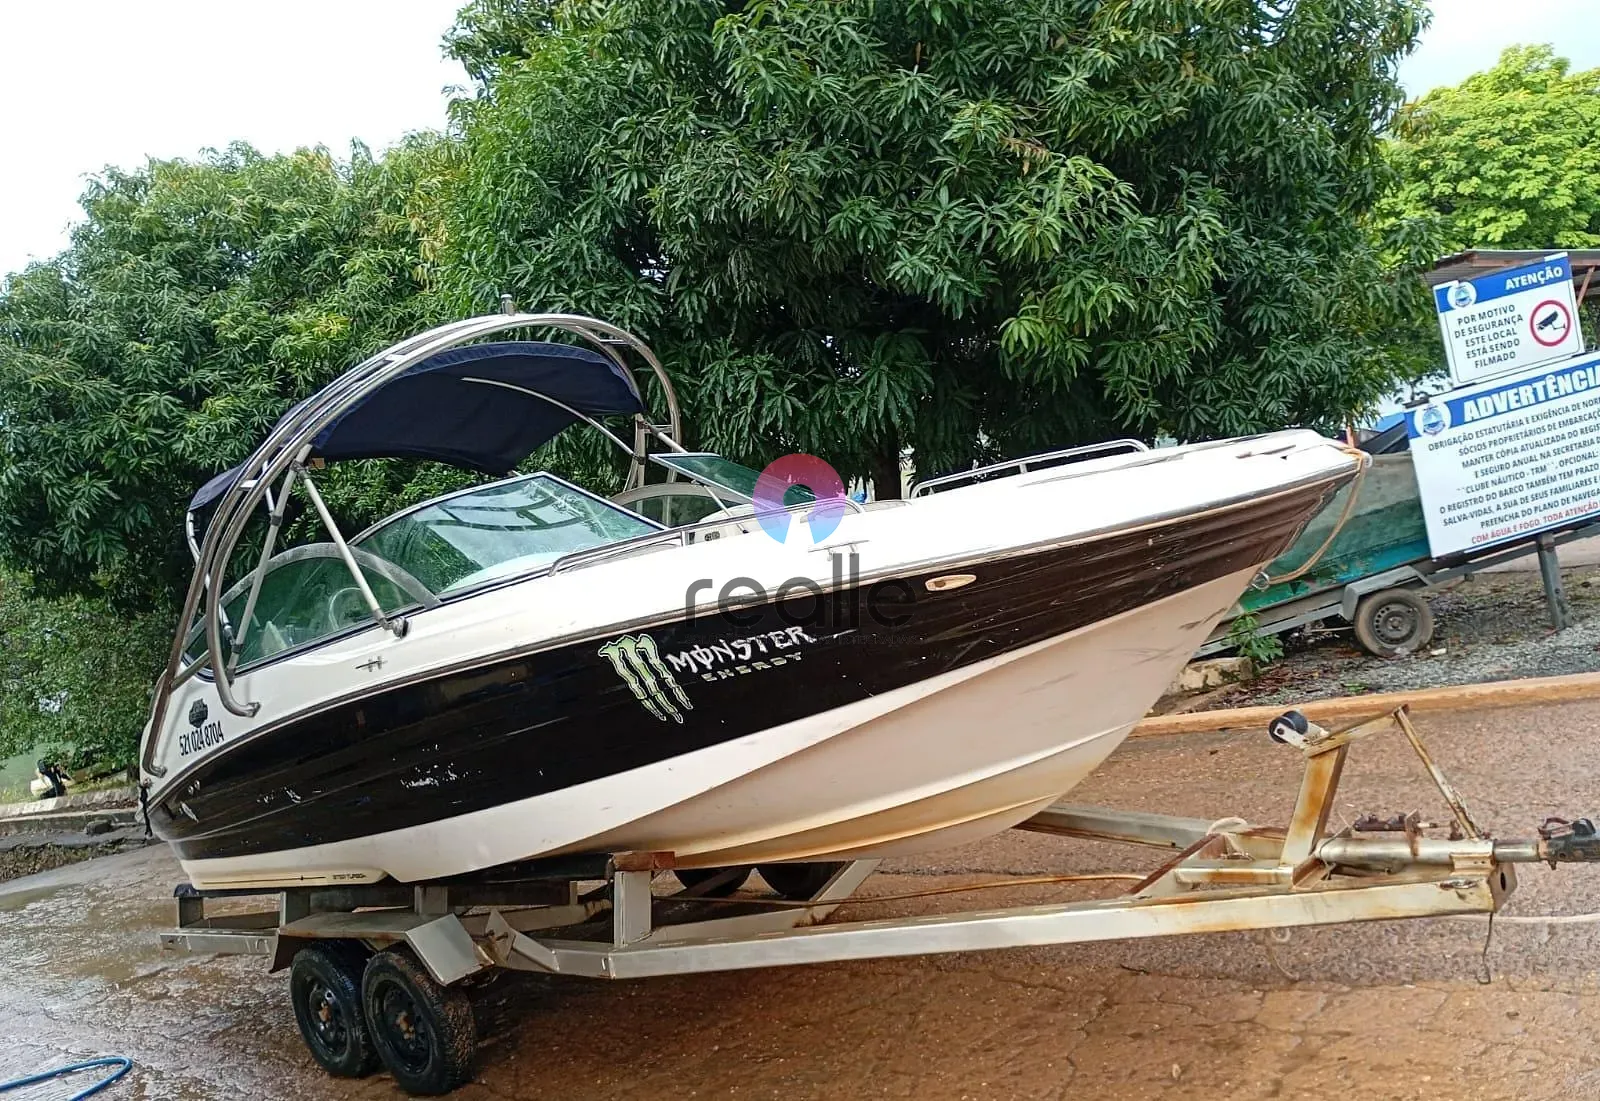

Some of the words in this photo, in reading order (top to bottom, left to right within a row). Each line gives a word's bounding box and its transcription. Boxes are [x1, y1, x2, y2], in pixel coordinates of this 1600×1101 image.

[1505, 266, 1563, 290] ATENÇÃO
[1455, 328, 1466, 338] DE
[1469, 314, 1523, 335] SEGURANÇA
[1458, 314, 1477, 326] POR
[1479, 304, 1515, 321] MOTIVO
[1466, 335, 1486, 347] ESTE
[1488, 328, 1517, 343] LOCAL
[1466, 344, 1488, 359] ESTÁ
[1490, 338, 1520, 352] SENDO
[1475, 352, 1516, 368] FILMADO
[1429, 432, 1474, 451] OBRIGAÇÃO
[1476, 418, 1523, 440] ESTATUTÁRIA
[1527, 416, 1530, 425] E
[1532, 408, 1570, 423] EXIGÊNCIA
[1573, 403, 1582, 413] DE
[1459, 442, 1486, 456] SÓCIOS
[1489, 426, 1546, 451] PROPRIETÁRIOS
[1548, 423, 1557, 433] DE
[1463, 455, 1494, 468] MANTER
[1497, 447, 1518, 461] CÓPIA
[1521, 434, 1566, 455] ATUALIZADA
[1568, 432, 1578, 441] DO
[1580, 424, 1600, 438] REGIS
[1475, 470, 1479, 478] E
[1481, 462, 1511, 476] SEGURO
[1513, 455, 1538, 470] ANUAL
[1541, 450, 1551, 460] NA
[1553, 439, 1594, 459] SECRETARIA
[1440, 506, 1446, 514] O
[1448, 494, 1485, 512] REGISTRO
[1486, 491, 1497, 501] DO
[1500, 484, 1524, 498] BARCO
[1527, 474, 1557, 491] TAMBÉM
[1559, 471, 1573, 481] TEM
[1575, 463, 1599, 477] PRAZO
[1492, 471, 1525, 489] NÁUTICO
[1497, 503, 1502, 512] A
[1504, 498, 1518, 509] SUA
[1520, 494, 1529, 504] DE
[1531, 489, 1548, 501] SEUS
[1550, 478, 1592, 497] FAMILIARES
[1472, 532, 1489, 544] COM
[1513, 523, 1518, 532] E
[1543, 512, 1564, 525] TODA
[1565, 501, 1598, 521] ATENÇÃO
[1481, 512, 1520, 529] PREENCHA
[1522, 506, 1532, 517] DO
[1535, 499, 1559, 515] PLANO
[1561, 497, 1570, 507] DE
[701, 651, 803, 682] ENERGY
[179, 733, 191, 756] 521
[192, 728, 205, 751] 024
[204, 720, 224, 746] 8704
